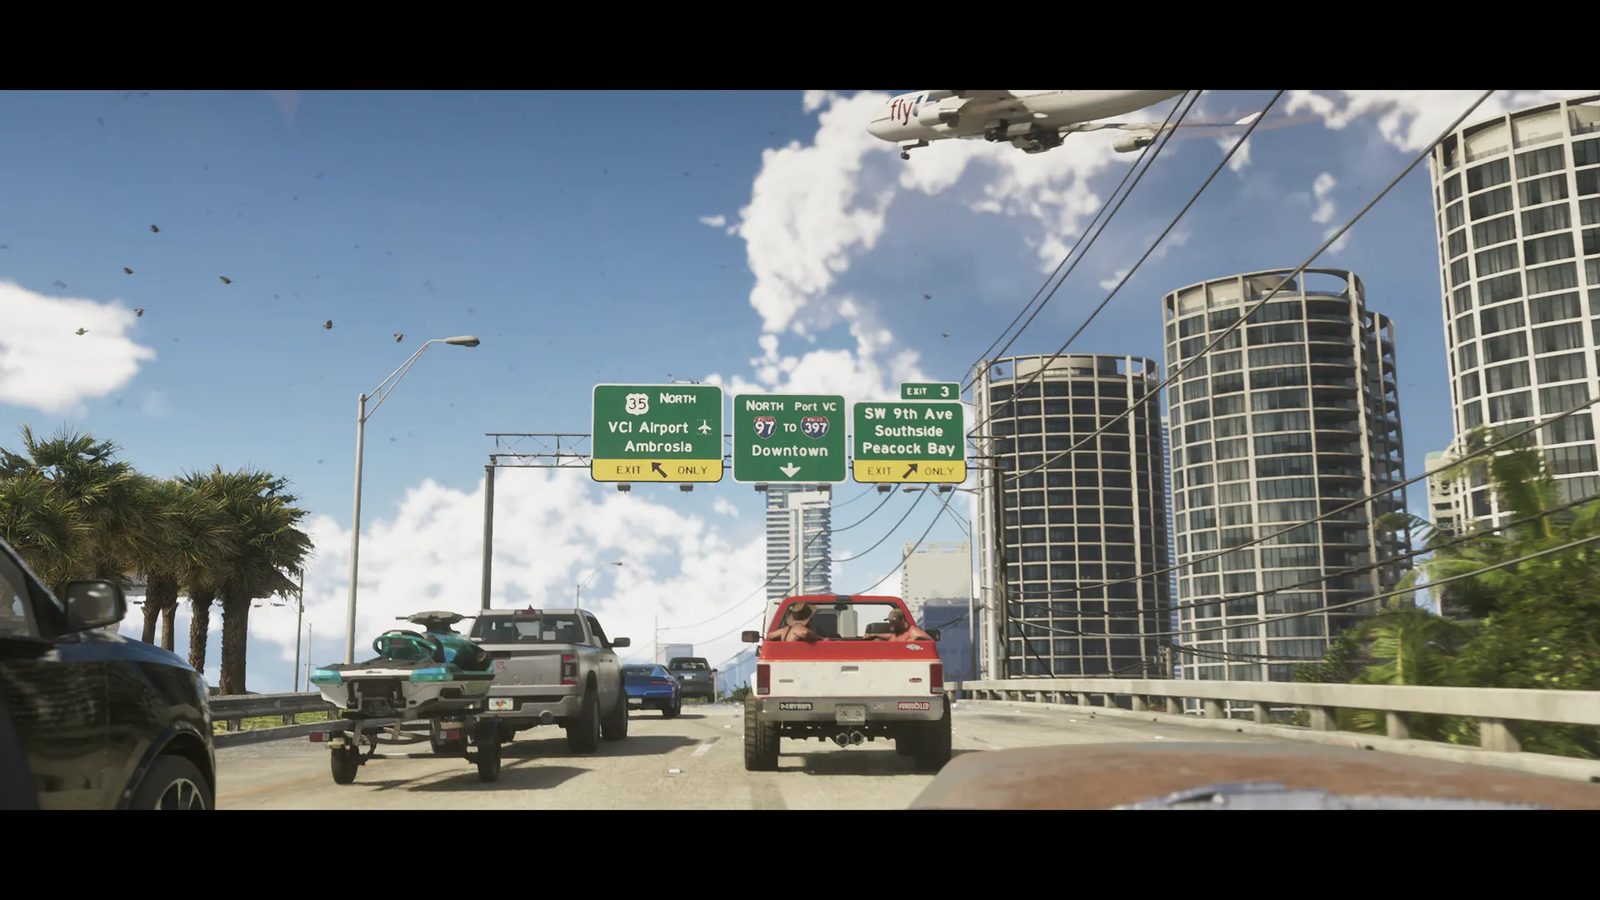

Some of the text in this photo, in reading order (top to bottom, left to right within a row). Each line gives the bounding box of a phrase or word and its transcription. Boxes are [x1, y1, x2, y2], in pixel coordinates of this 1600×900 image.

[891, 99, 914, 126] fly
[906, 386, 949, 397] EXIT 3
[628, 392, 696, 410] 35 NORTH
[746, 400, 837, 411] NORTH Port VC
[864, 407, 953, 420] SW 9th Ave
[608, 421, 689, 436] VCI Airport
[754, 421, 828, 434] 97 TO 397
[875, 425, 944, 437] Southside
[624, 440, 693, 453] Ambrosia
[752, 444, 829, 457] Downtown
[862, 442, 956, 457] Peacock Bay
[616, 465, 709, 476] EXIT ONLY
[867, 467, 955, 476] EXIT ONLY
